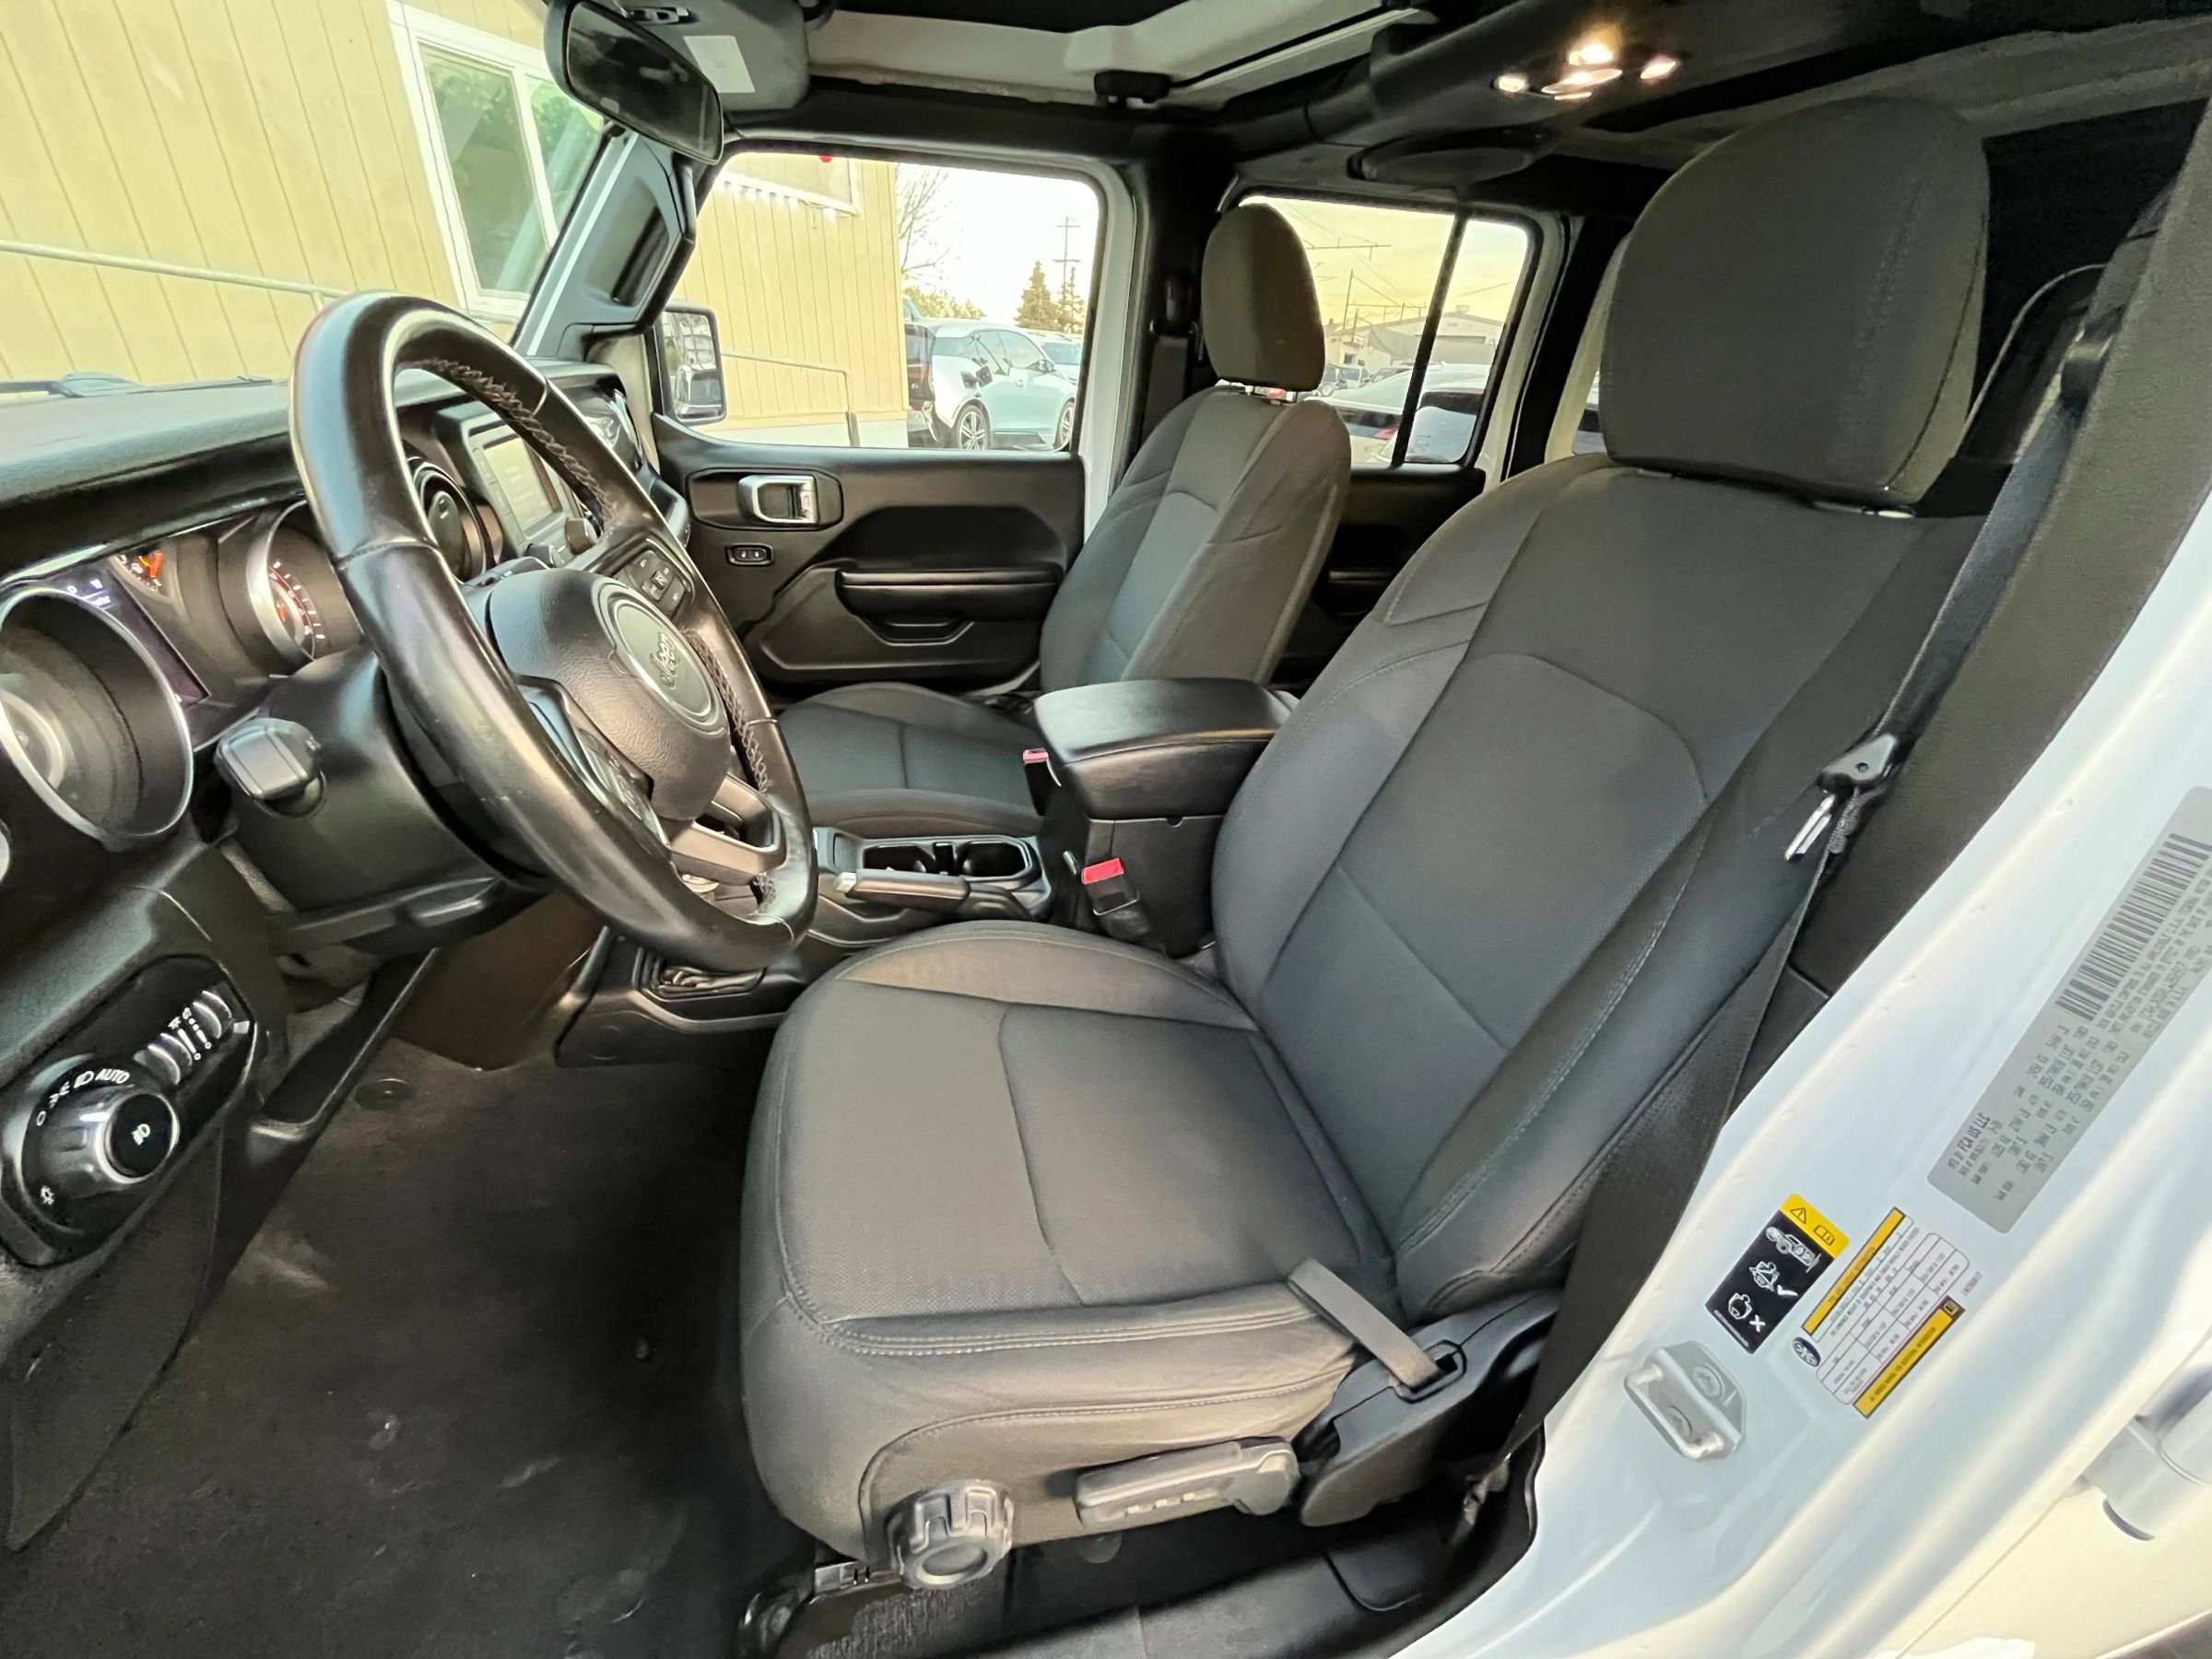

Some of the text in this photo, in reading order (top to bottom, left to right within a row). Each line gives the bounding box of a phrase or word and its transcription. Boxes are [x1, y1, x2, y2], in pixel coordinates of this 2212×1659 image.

[95, 1068, 130, 1084] AUTO
[1972, 1112, 1991, 1128] LLC
[1966, 1125, 1982, 1138] US
[1957, 1136, 1975, 1152] FCA
